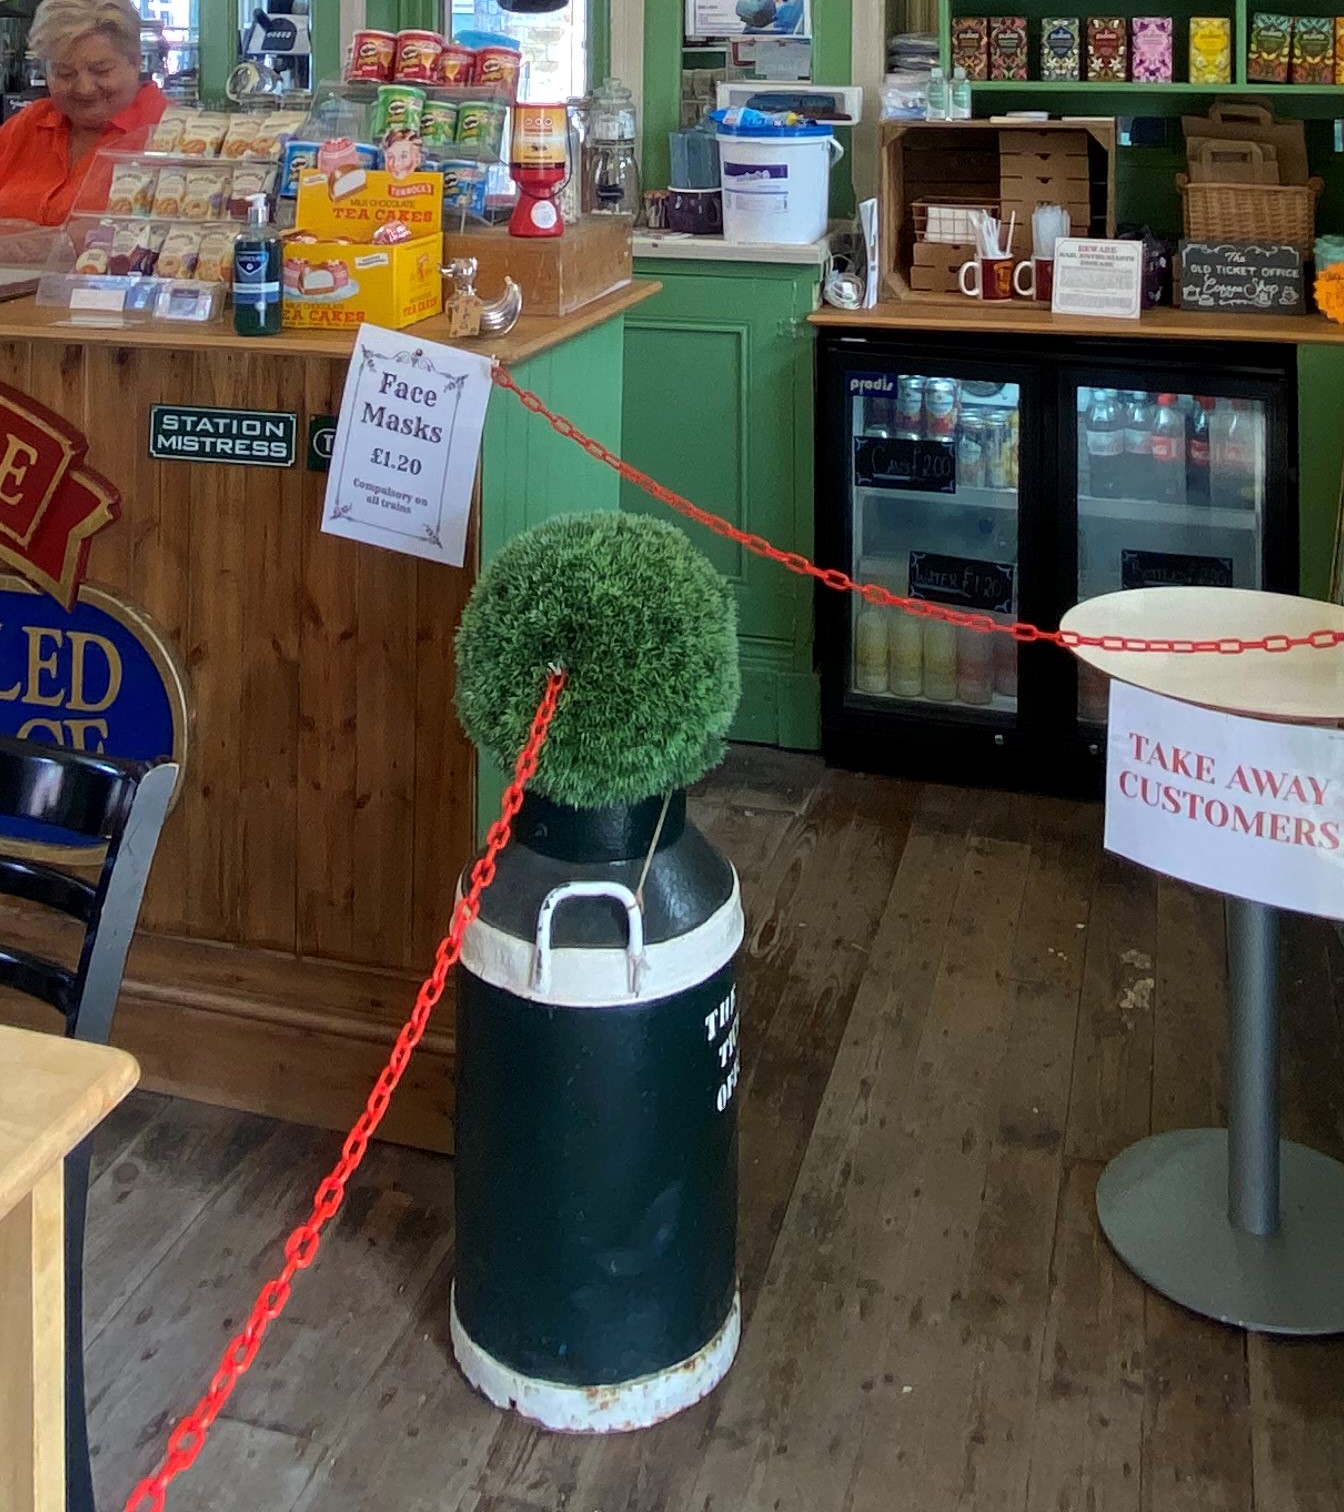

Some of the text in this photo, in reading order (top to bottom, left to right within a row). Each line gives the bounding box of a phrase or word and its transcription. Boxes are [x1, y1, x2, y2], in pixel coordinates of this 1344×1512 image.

[333, 207, 433, 223] TEA CAKES
[1225, 251, 1246, 263] The
[1190, 264, 1300, 278] OLD TICKET OFFICE
[282, 309, 365, 322] EA CAKES
[378, 371, 438, 408] Face
[162, 415, 285, 437] STATION
[361, 402, 443, 444] Masks
[157, 434, 287, 458] MISTRESS
[370, 447, 422, 476] £1.20
[352, 477, 429, 507] Compulsory on
[366, 494, 413, 515] all trains
[1129, 732, 1333, 806] TAKE AWAY
[1119, 769, 1340, 850] CUSTOMERS
